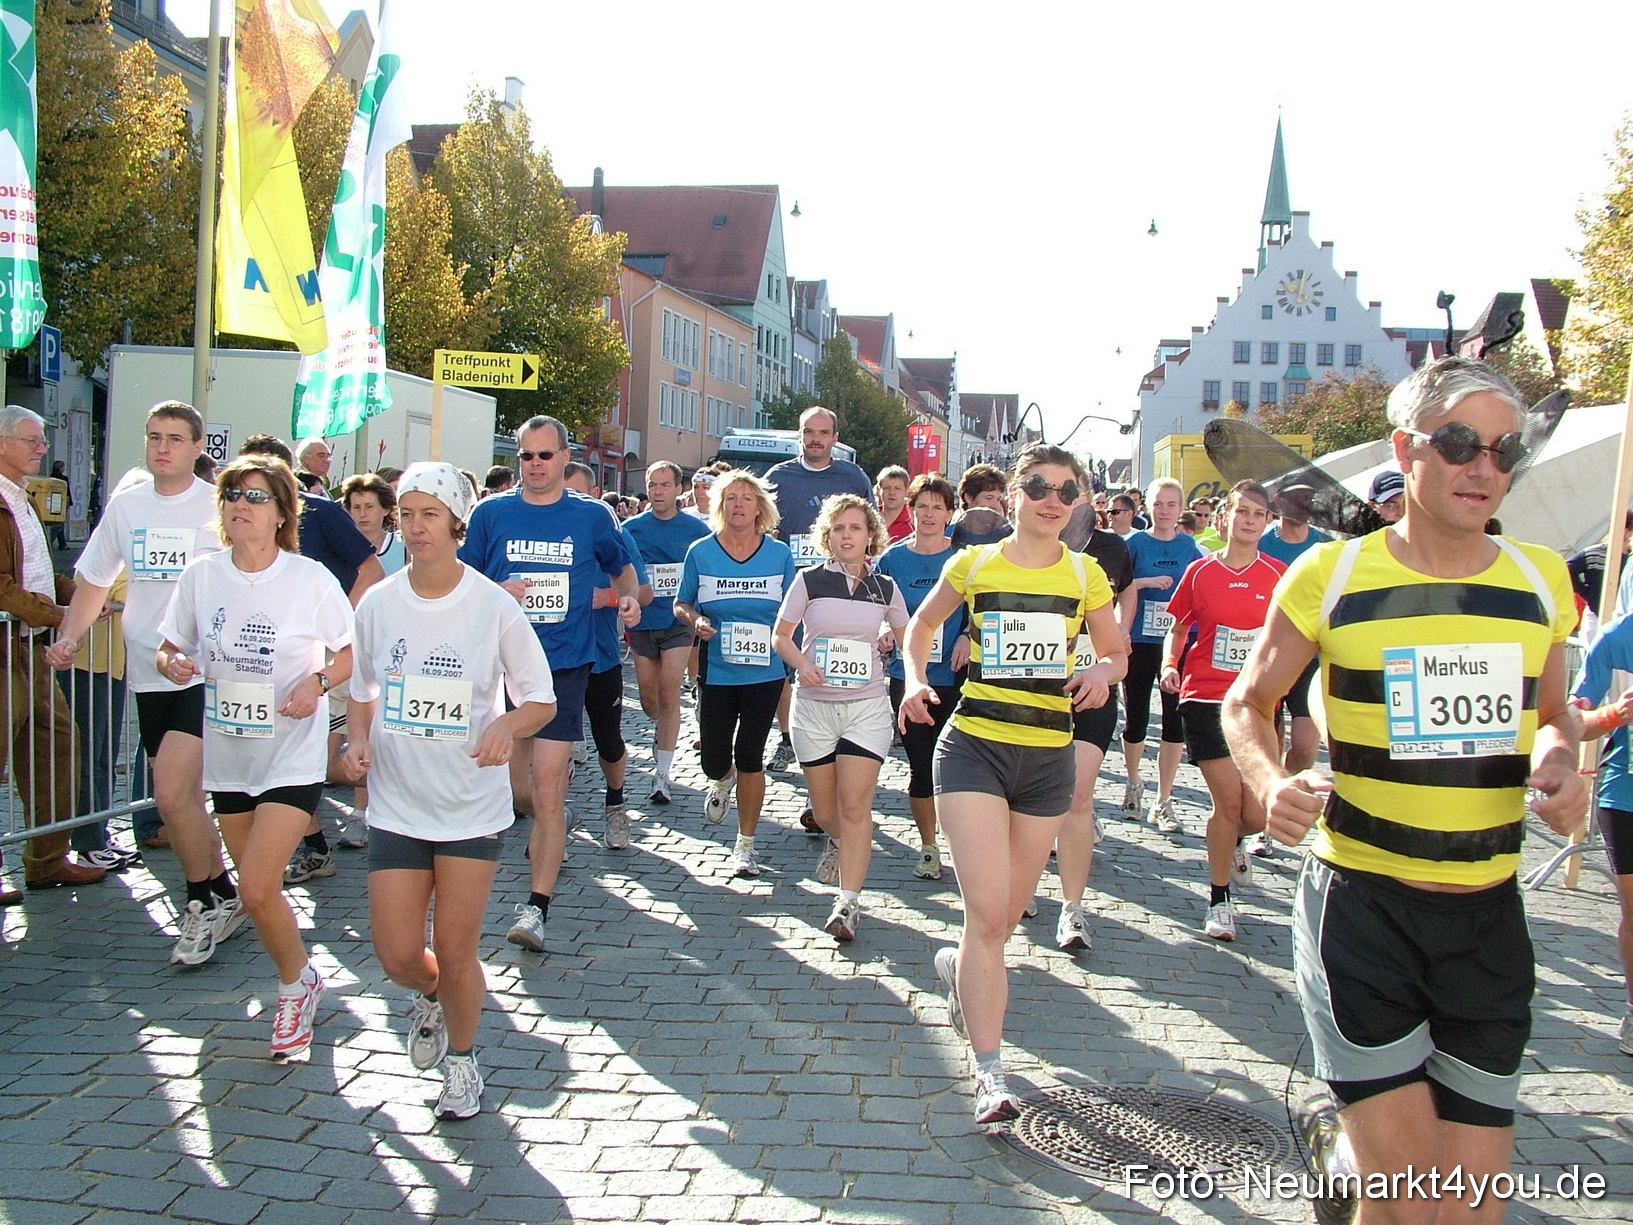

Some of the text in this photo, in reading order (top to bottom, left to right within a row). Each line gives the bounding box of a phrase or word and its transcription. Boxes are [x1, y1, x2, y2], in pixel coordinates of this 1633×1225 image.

[45, 333, 56, 373] P
[442, 353, 511, 368] Treffpunkt
[442, 369, 514, 386] Bladenight
[73, 415, 85, 519] INDIGO
[506, 539, 574, 557] HUBER
[148, 551, 187, 566] 3741
[520, 555, 571, 564] TECHNOLOGY
[716, 579, 768, 590] Margraf
[525, 595, 565, 609] 3058
[734, 626, 753, 637] Helga
[1002, 618, 1026, 634] julia
[239, 634, 277, 644] 16.09.2007
[1229, 632, 1255, 642] Carolin
[734, 640, 767, 654] 3438
[829, 643, 849, 653] Julia
[1005, 642, 1059, 661] 2707
[1229, 648, 1252, 660] 33
[223, 655, 274, 667] Neumarkter
[829, 660, 868, 676] 2303
[1423, 655, 1489, 677] Markus
[235, 663, 274, 675] Stadtlauf
[420, 667, 464, 679] 16.09.2007
[1033, 668, 1066, 676] PFLEIDERER
[1392, 691, 1401, 707] C
[220, 700, 269, 721] 3715
[407, 699, 464, 722] 3714
[1429, 693, 1513, 727] 3036
[434, 728, 468, 737] PFLEIDERER
